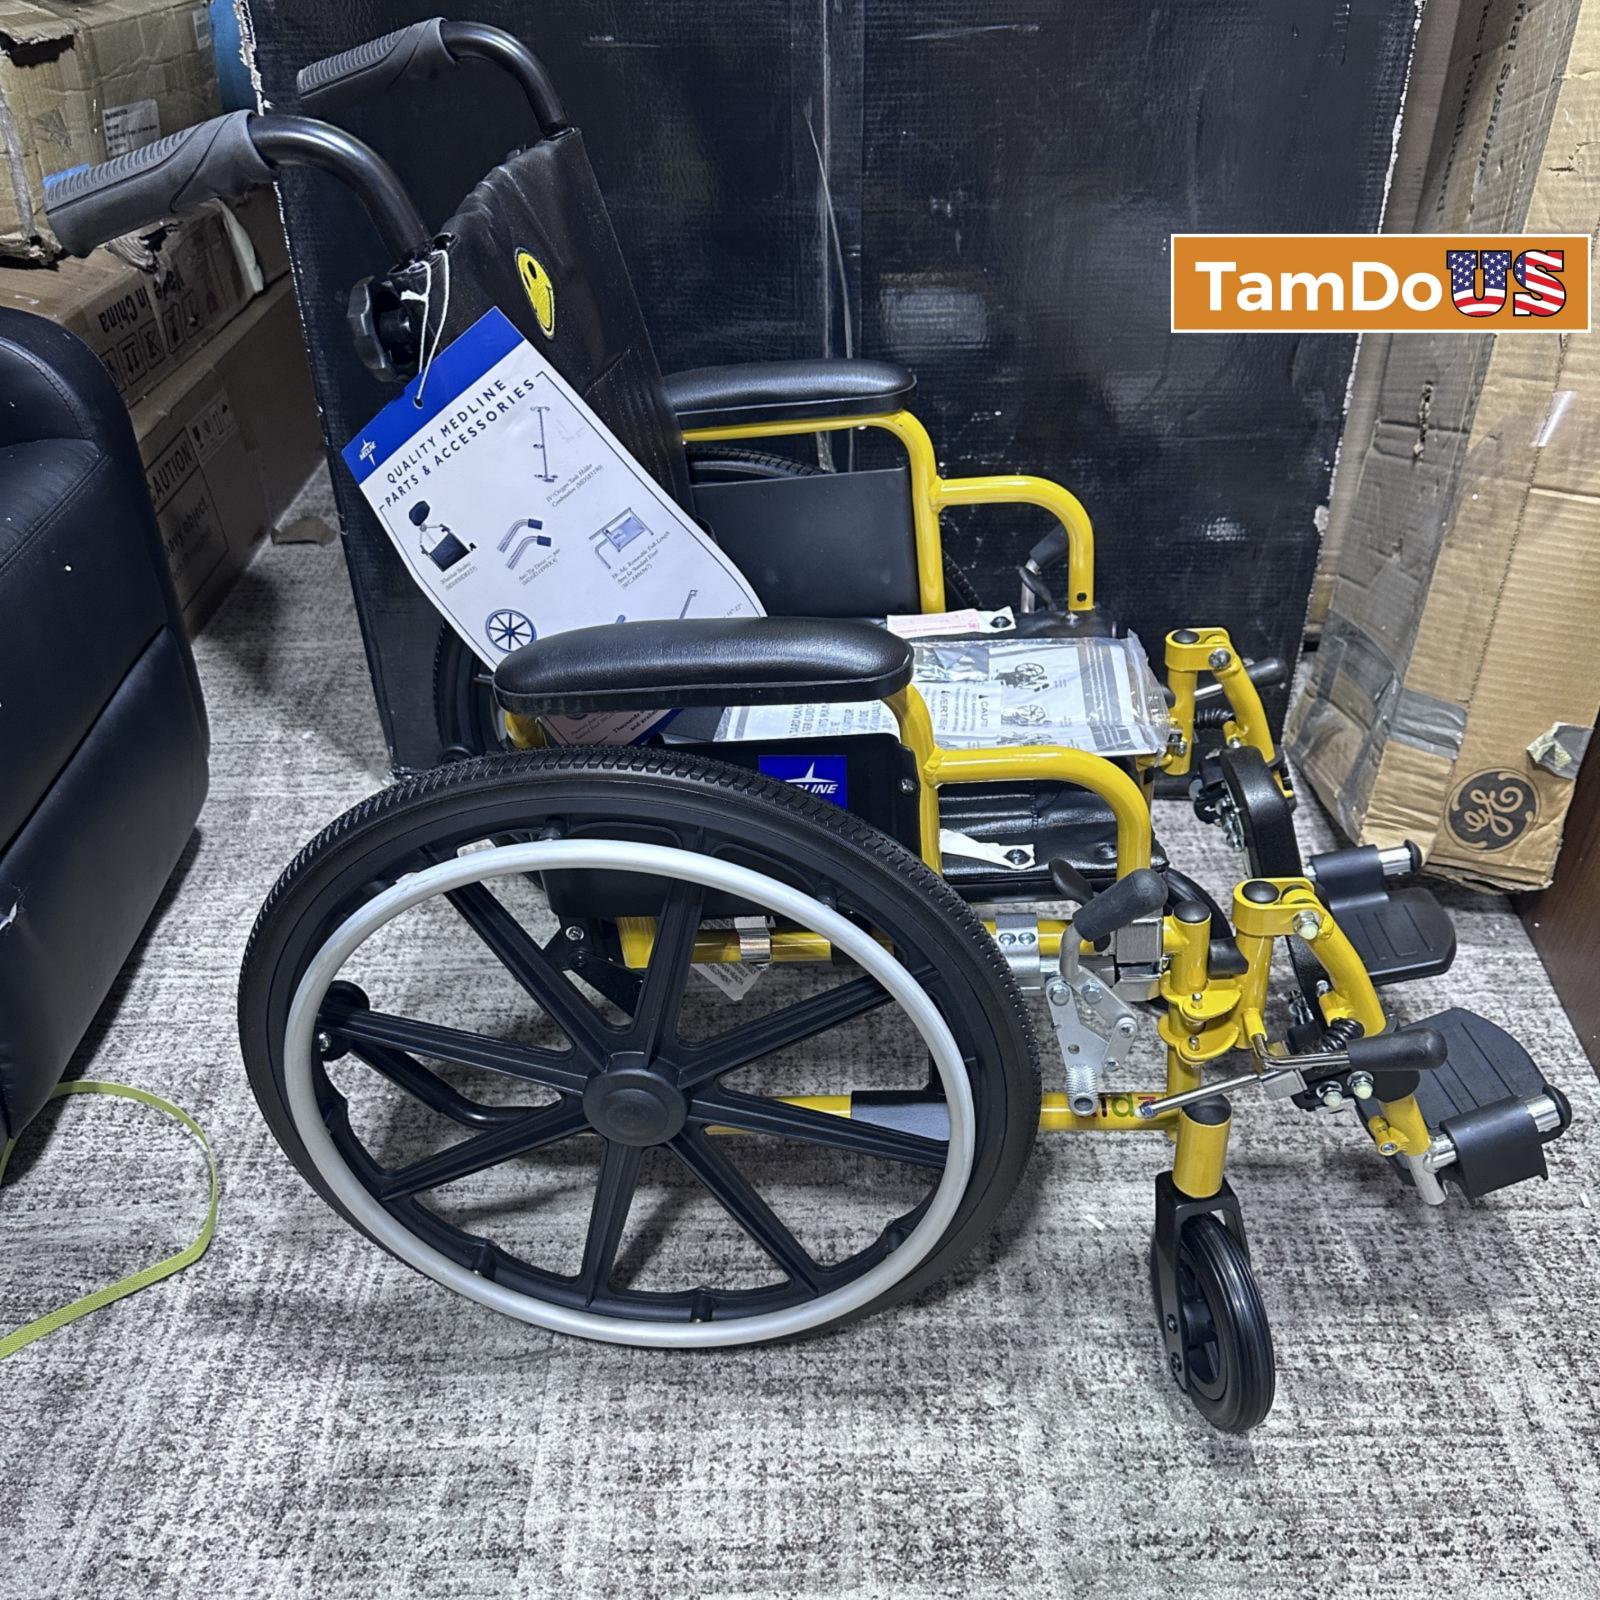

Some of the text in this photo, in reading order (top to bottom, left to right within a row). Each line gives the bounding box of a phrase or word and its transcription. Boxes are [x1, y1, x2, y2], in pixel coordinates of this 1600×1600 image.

[98, 294, 138, 333] China
[152, 440, 193, 502] AUTION
[385, 379, 534, 507] PARTS & ACCESSORIES
[387, 379, 506, 484] QUALITY MEDLINE
